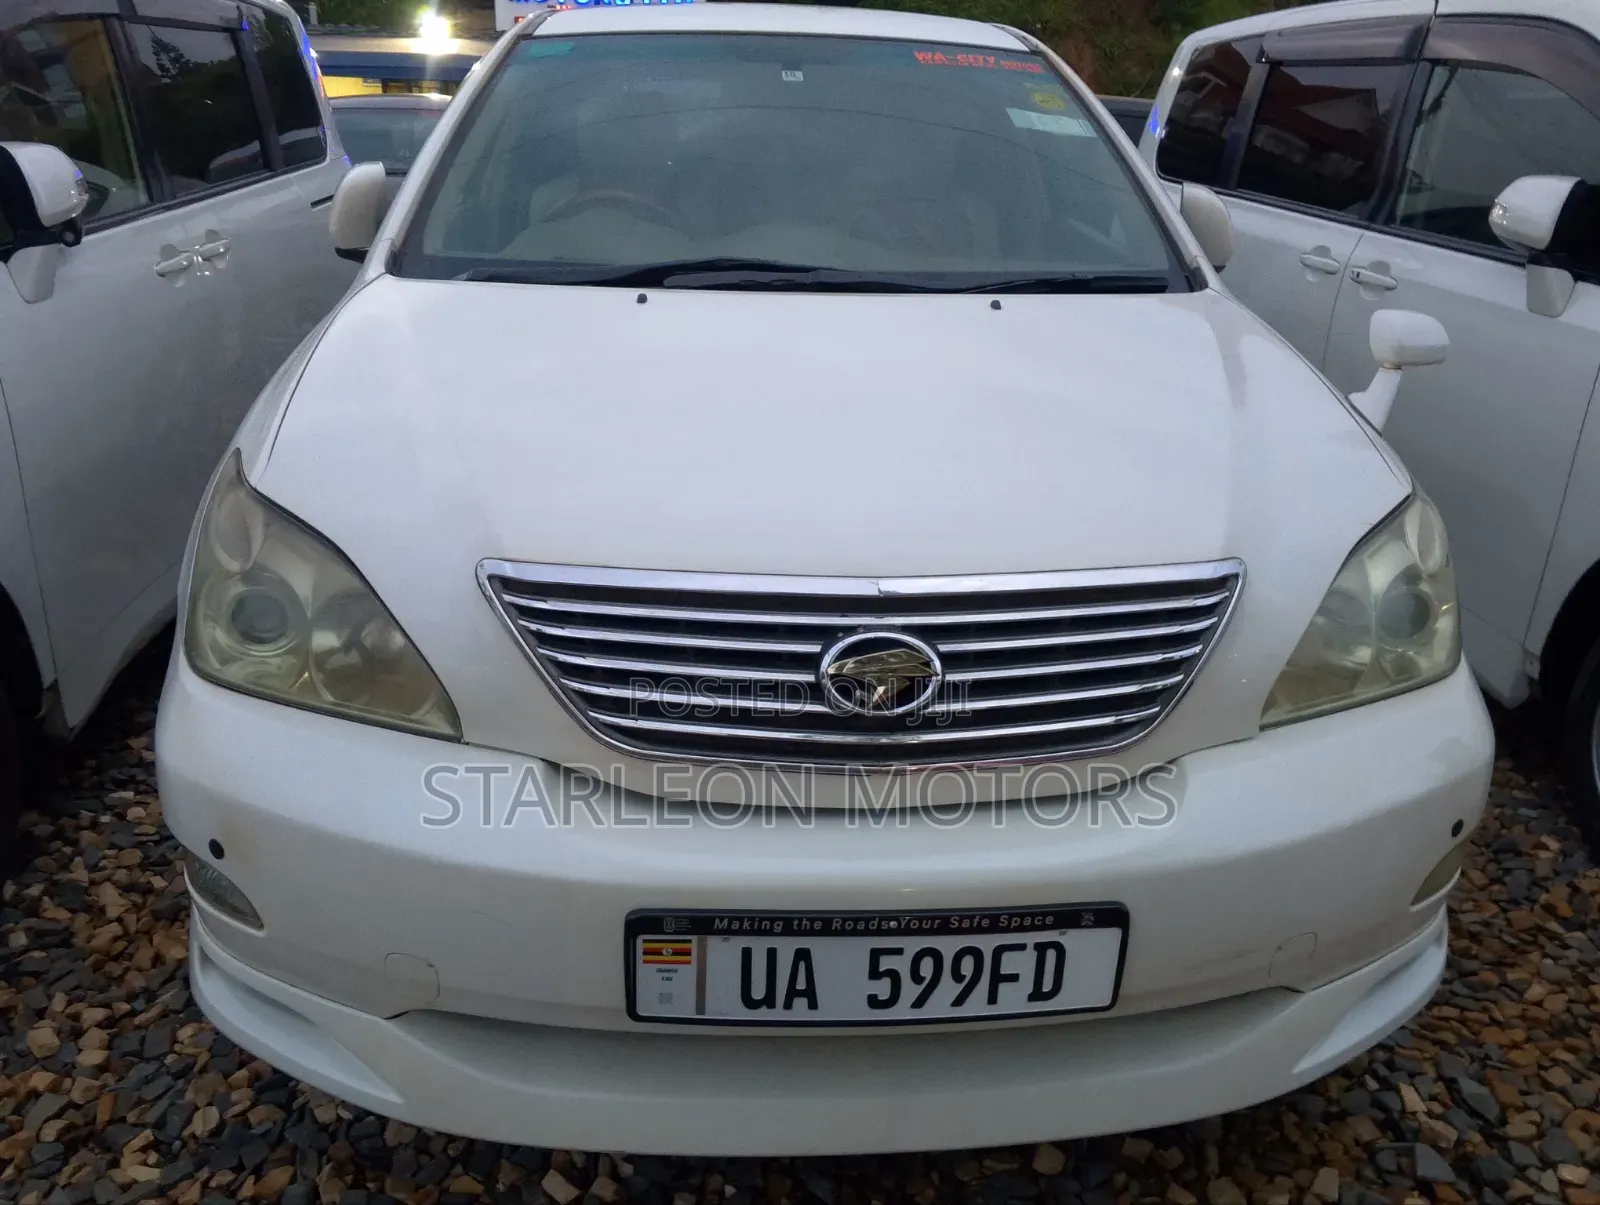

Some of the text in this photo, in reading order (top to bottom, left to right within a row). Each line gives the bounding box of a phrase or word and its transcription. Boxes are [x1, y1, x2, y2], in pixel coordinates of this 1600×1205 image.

[714, 917, 783, 933] Making
[793, 917, 822, 930] the
[900, 917, 941, 930] Your
[949, 915, 991, 928] Safe
[999, 914, 1054, 929] Space
[740, 940, 1067, 1011] UA 599FD
